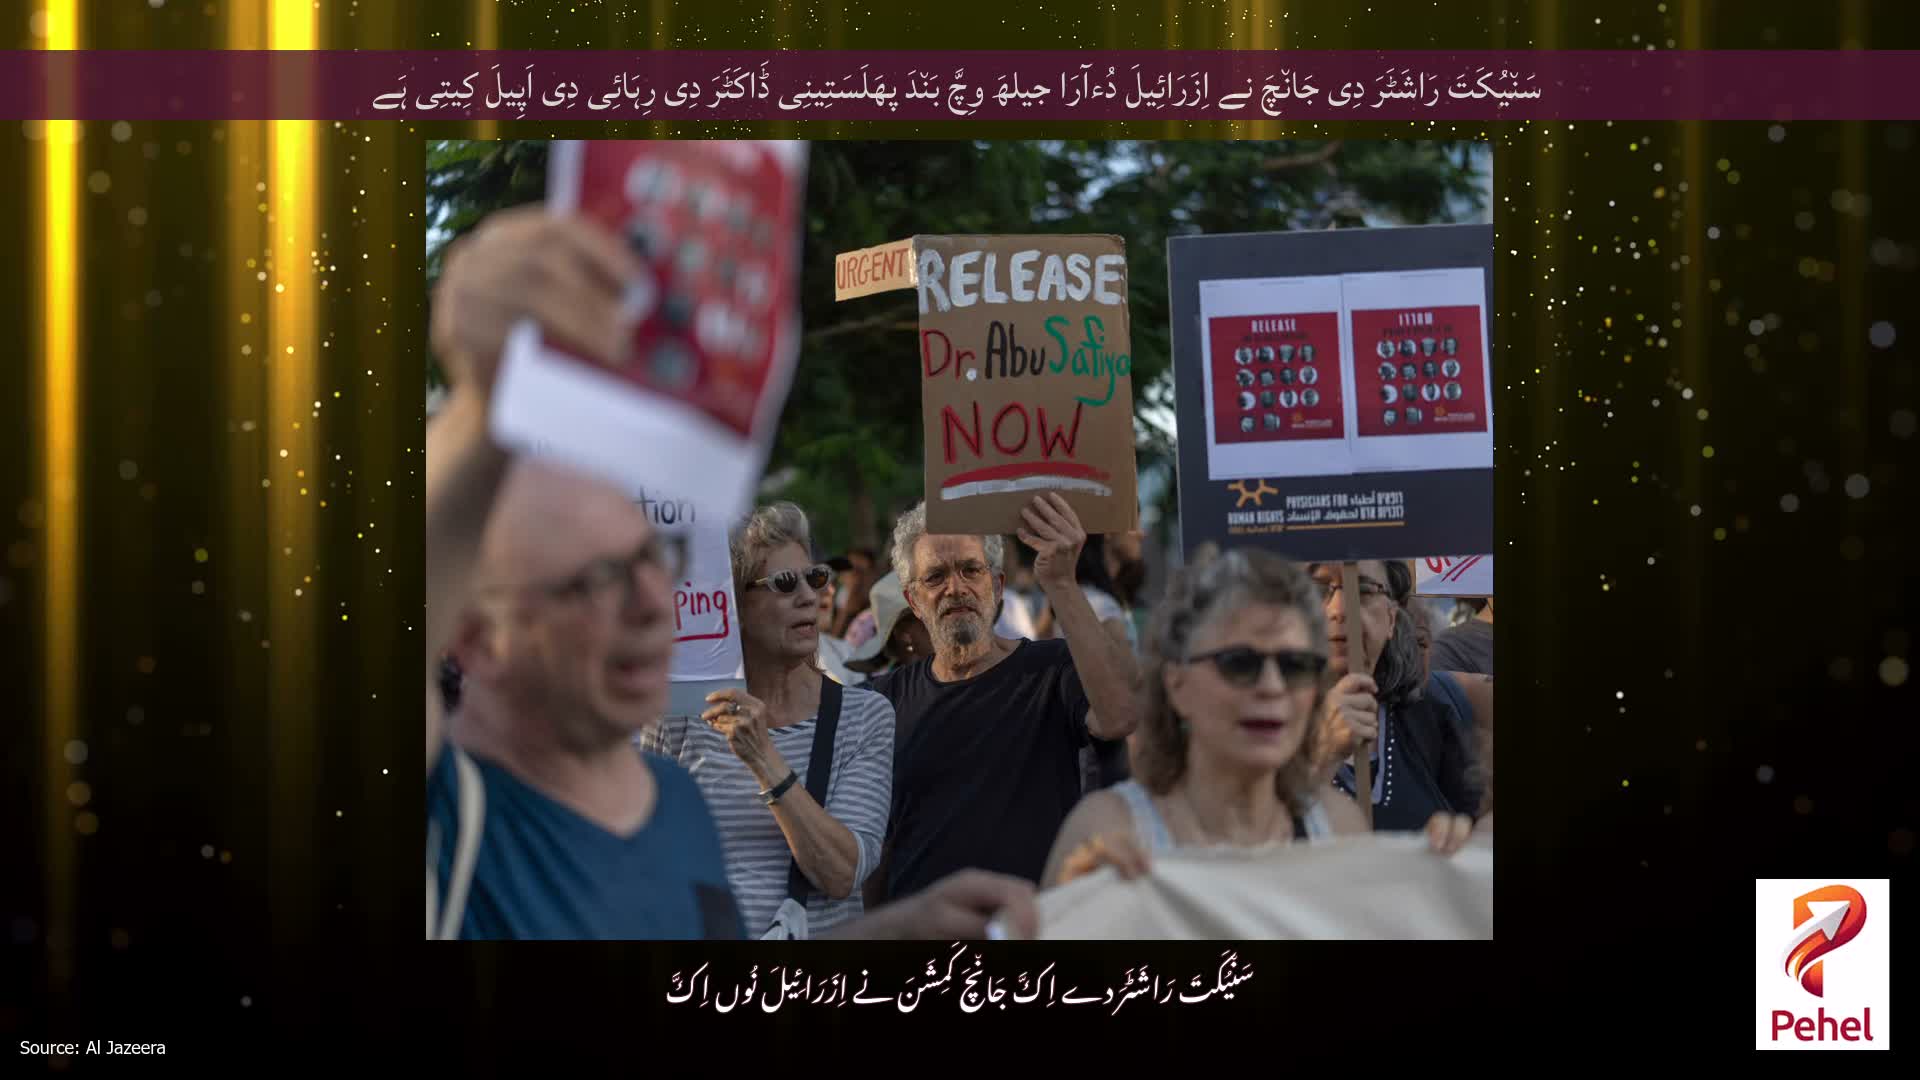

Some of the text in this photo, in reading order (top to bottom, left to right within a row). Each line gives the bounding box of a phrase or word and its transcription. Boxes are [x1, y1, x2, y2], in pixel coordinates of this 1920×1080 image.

[836, 247, 909, 290] URGENT
[919, 249, 1126, 313] RELEASE
[920, 329, 977, 381] Dr.
[985, 320, 1047, 379] Abu
[1251, 317, 1296, 333] RELEASE
[941, 401, 1084, 464] NOW
[633, 485, 695, 524] tion
[673, 582, 729, 638] ping
